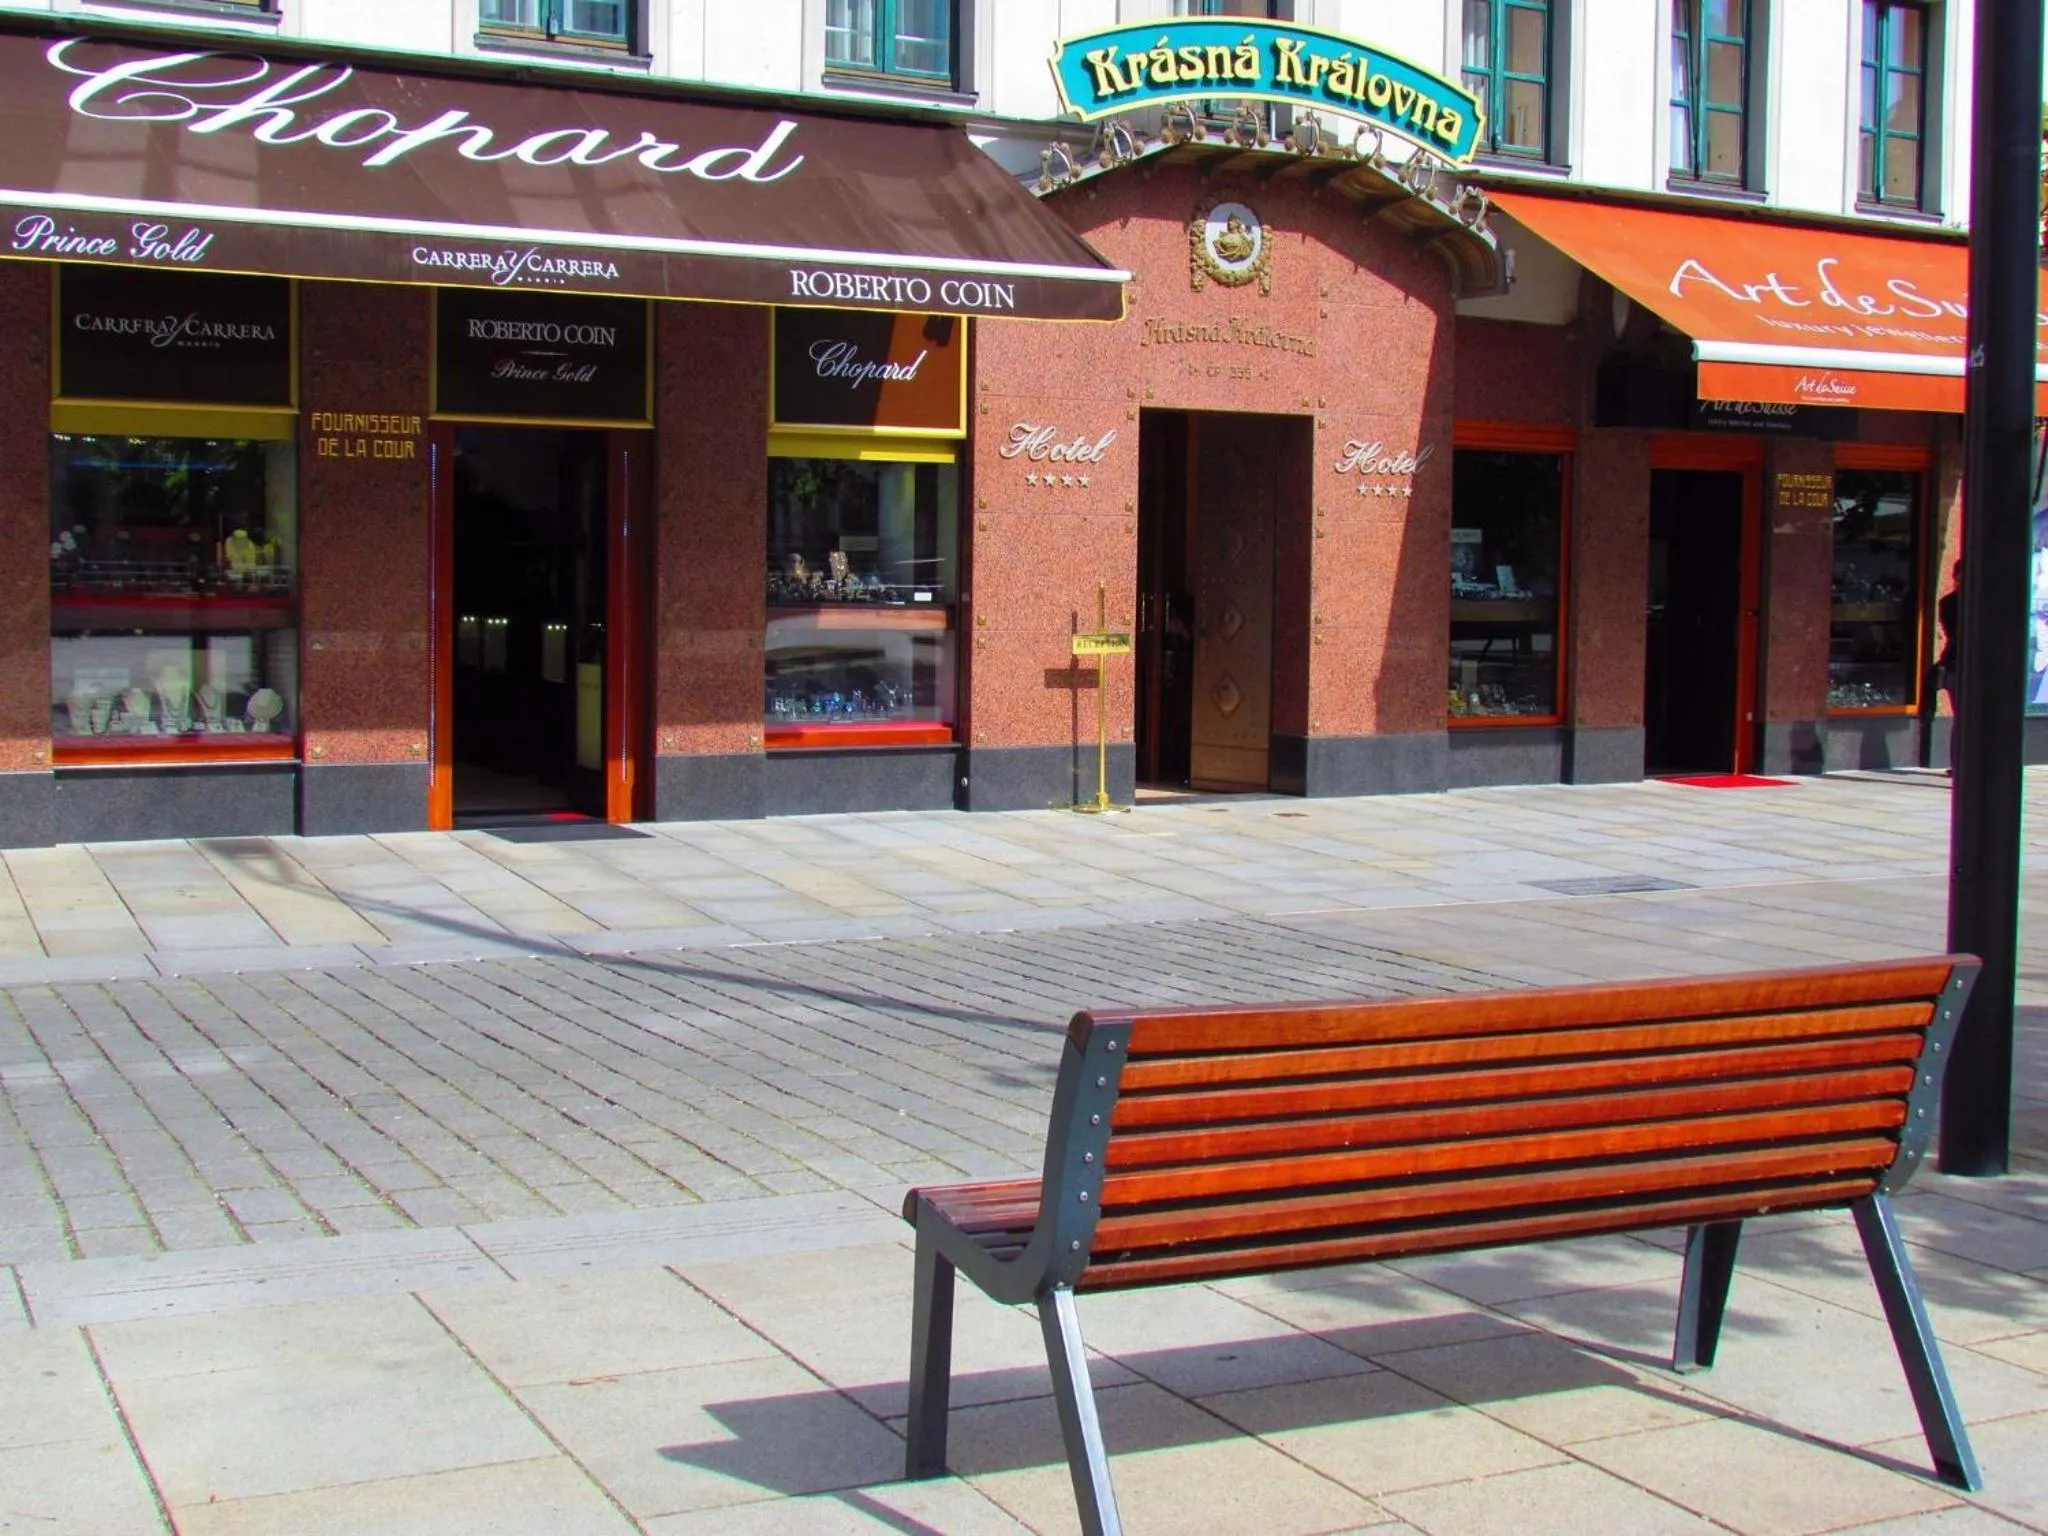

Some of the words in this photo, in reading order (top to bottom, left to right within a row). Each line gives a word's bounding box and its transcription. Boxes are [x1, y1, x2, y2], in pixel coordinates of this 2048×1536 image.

[1086, 34, 1261, 98] Krásná
[1275, 36, 1463, 144] Královna
[46, 38, 805, 182] Chopard
[12, 214, 118, 255] Prince
[130, 222, 214, 262] Gold
[412, 246, 509, 271] CARRERA
[527, 254, 620, 279] CARRERA
[789, 269, 931, 304] ROBERTO
[940, 279, 1016, 309] COIN
[1668, 258, 1811, 306] Art
[1817, 257, 1895, 316] de
[185, 318, 276, 340] CARRERA
[467, 318, 561, 343] ROBERTO
[564, 324, 616, 347] COIN
[491, 359, 549, 381] Prince
[552, 362, 598, 382] Gold
[809, 339, 928, 390] Chopard
[1793, 375, 1817, 392] Art
[311, 412, 421, 435] FOURNISSEUR
[318, 437, 339, 457] DE
[344, 438, 367, 458] LA
[373, 439, 416, 460] COUR
[1000, 421, 1117, 463] Hotel
[1334, 439, 1436, 475] Hotel
